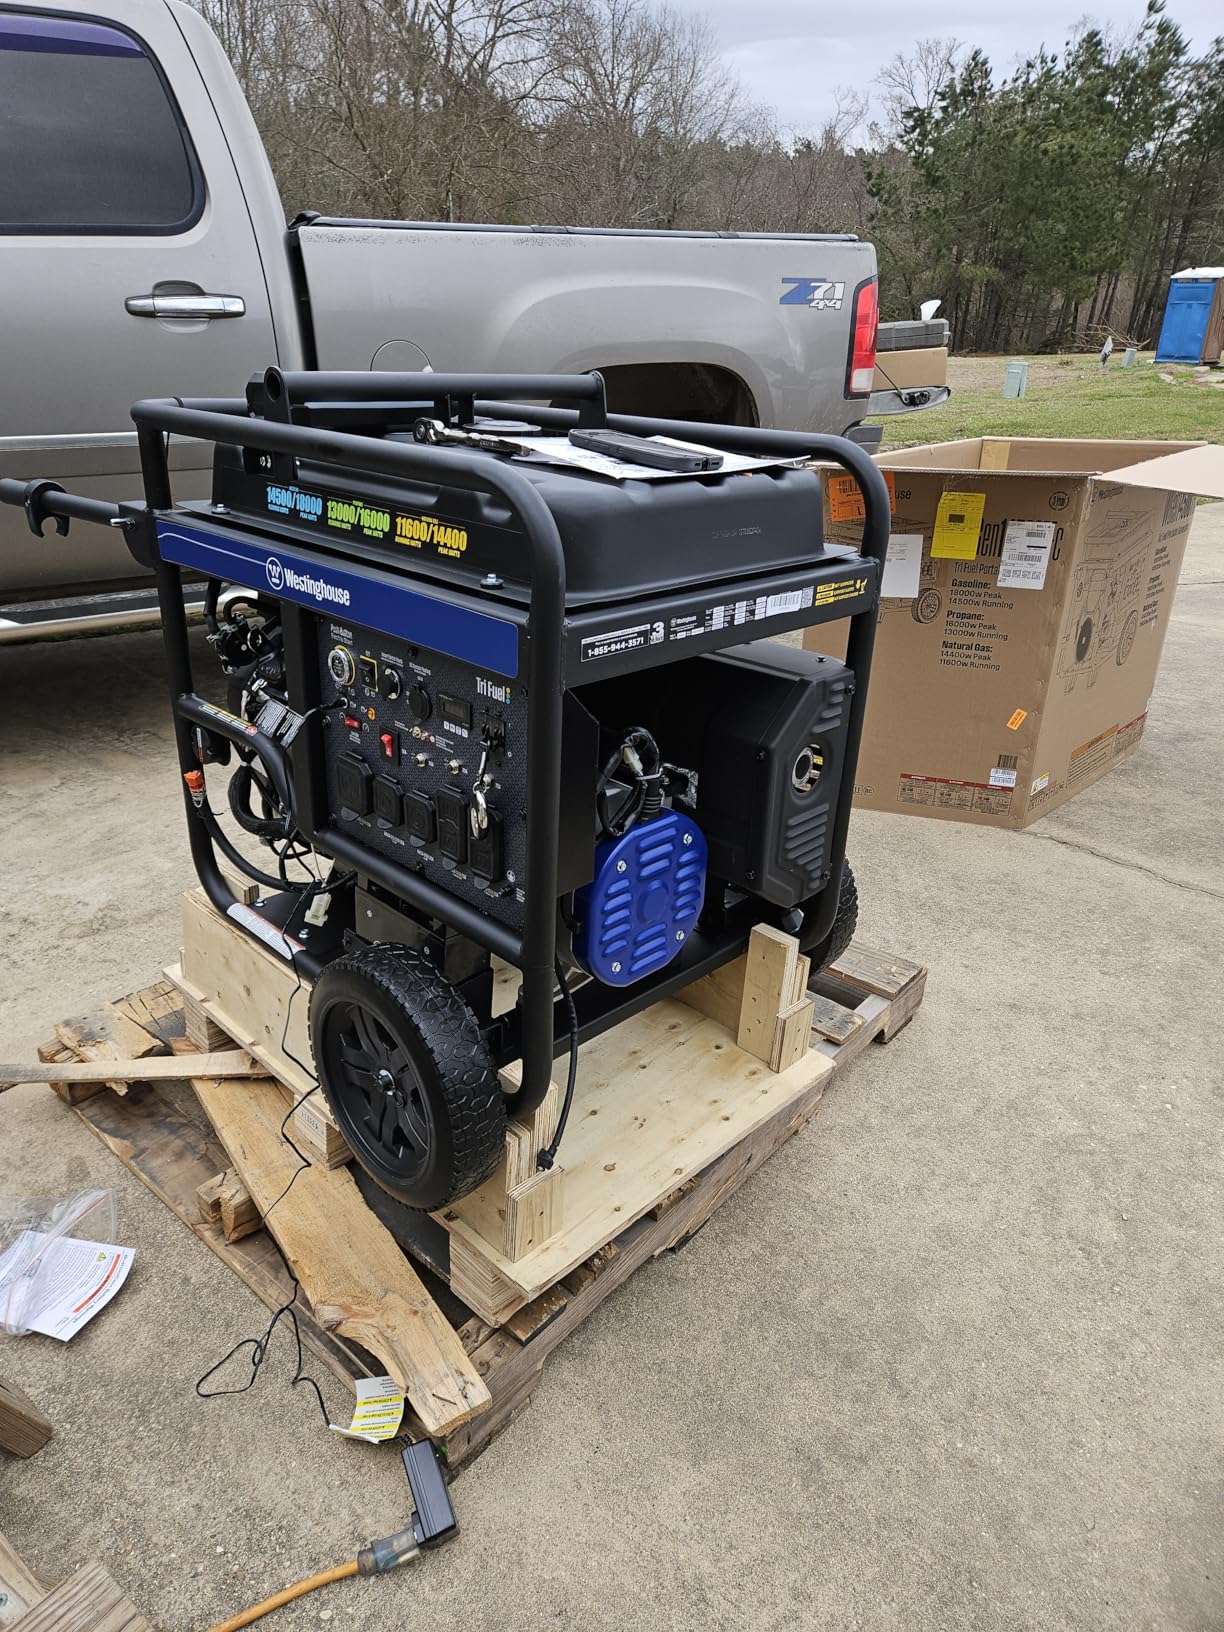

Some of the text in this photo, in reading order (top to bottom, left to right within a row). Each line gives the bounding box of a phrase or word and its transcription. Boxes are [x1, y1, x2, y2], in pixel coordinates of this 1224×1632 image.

[780, 278, 845, 304] Z71
[267, 486, 322, 516] 14500/18000
[327, 500, 390, 532] 13000/16000
[396, 516, 467, 551] 11600/14400
[954, 562, 964, 574] Tri
[964, 562, 978, 575] Fuel
[284, 568, 350, 606] Westinghouse
[951, 579, 991, 590] Gasoline:
[950, 589, 1002, 600] 18000w Peak
[982, 600, 1013, 610] Running
[946, 610, 985, 622] Propane:
[945, 620, 997, 631] 16000w Peak
[977, 631, 1008, 641] Running
[587, 637, 644, 657] 1-855-944-3571
[942, 640, 993, 653] Natural Gas:
[973, 653, 991, 661] Peak
[969, 661, 1000, 671] Running
[475, 676, 505, 703] Tri Fuel
